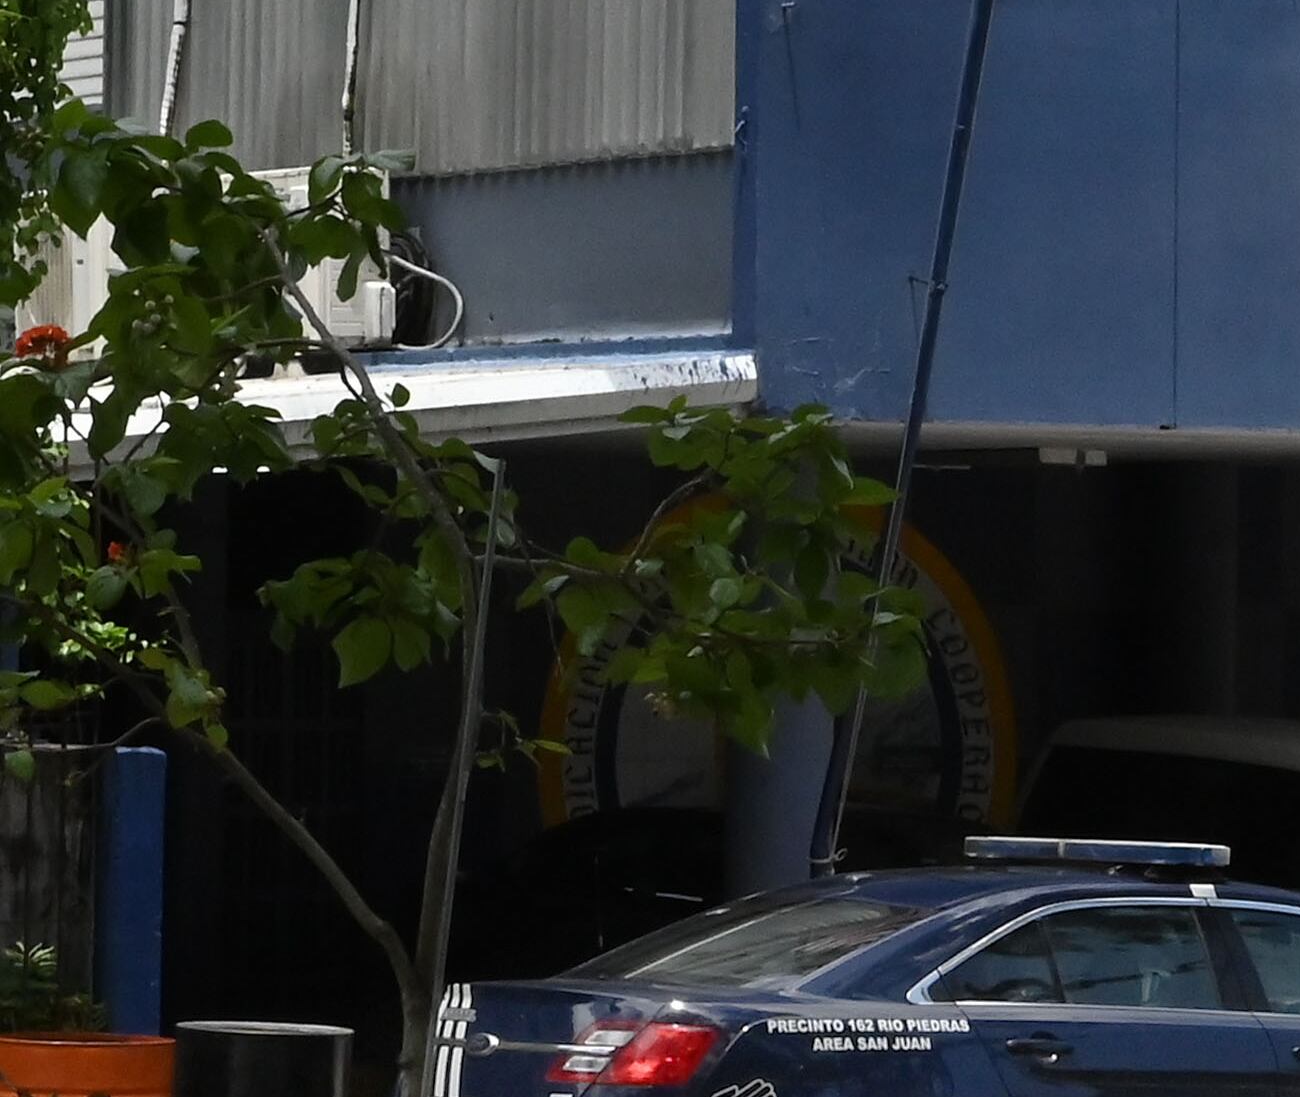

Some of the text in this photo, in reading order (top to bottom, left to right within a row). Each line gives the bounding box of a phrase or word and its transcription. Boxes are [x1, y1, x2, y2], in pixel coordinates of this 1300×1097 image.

[767, 1019, 970, 1033] PRECINTO 162 RIO PIEDRAS
[812, 1037, 932, 1051] AREA SAN JUAN
